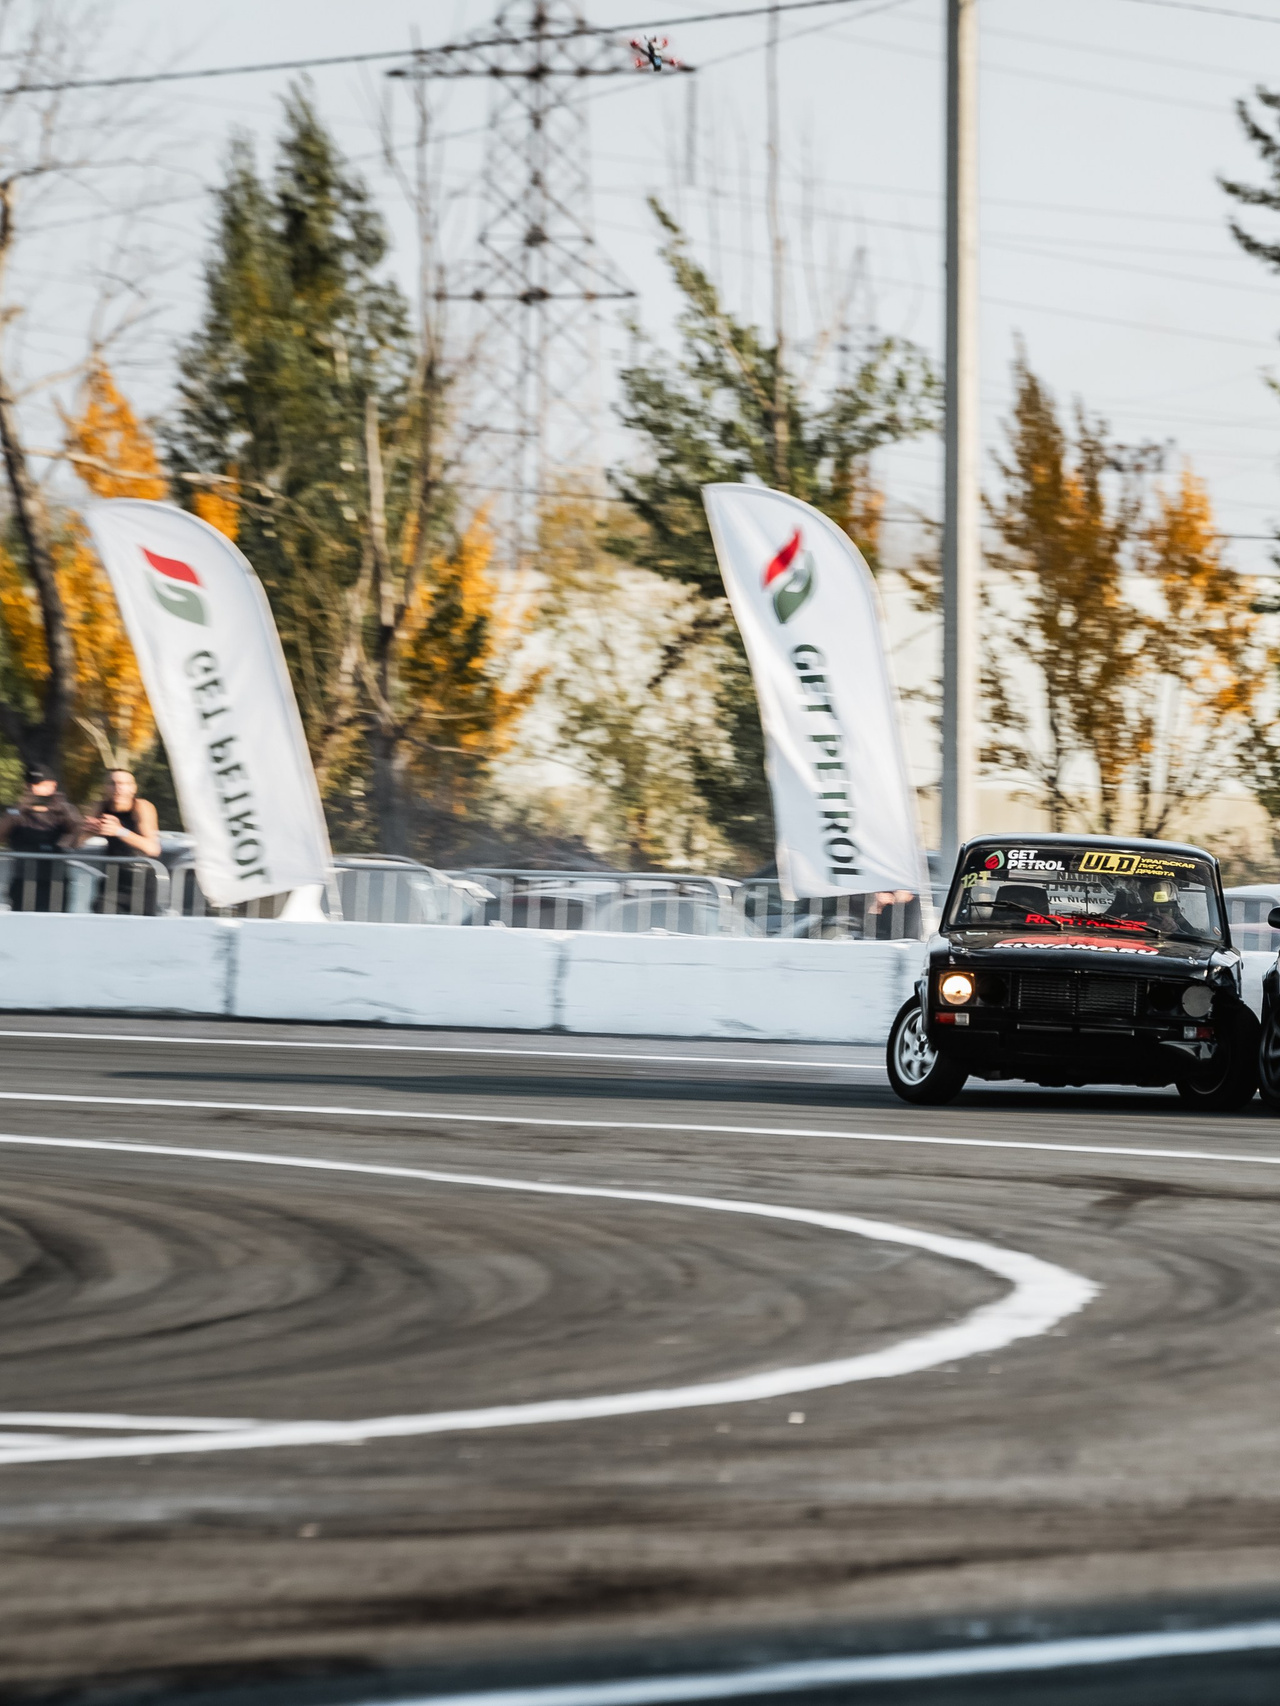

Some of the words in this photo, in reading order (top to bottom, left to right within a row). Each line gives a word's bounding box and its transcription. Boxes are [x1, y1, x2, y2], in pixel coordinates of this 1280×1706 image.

[791, 644, 840, 721] GET
[807, 734, 865, 887] PETROL
[1007, 849, 1039, 860] GET
[1006, 860, 1066, 871] PETROL
[1083, 854, 1138, 873] ULD
[1137, 863, 1164, 871] ЛИГА
[1140, 858, 1196, 870] УРАЛЬСКАЯ
[1135, 868, 1176, 878] ДРИФТА
